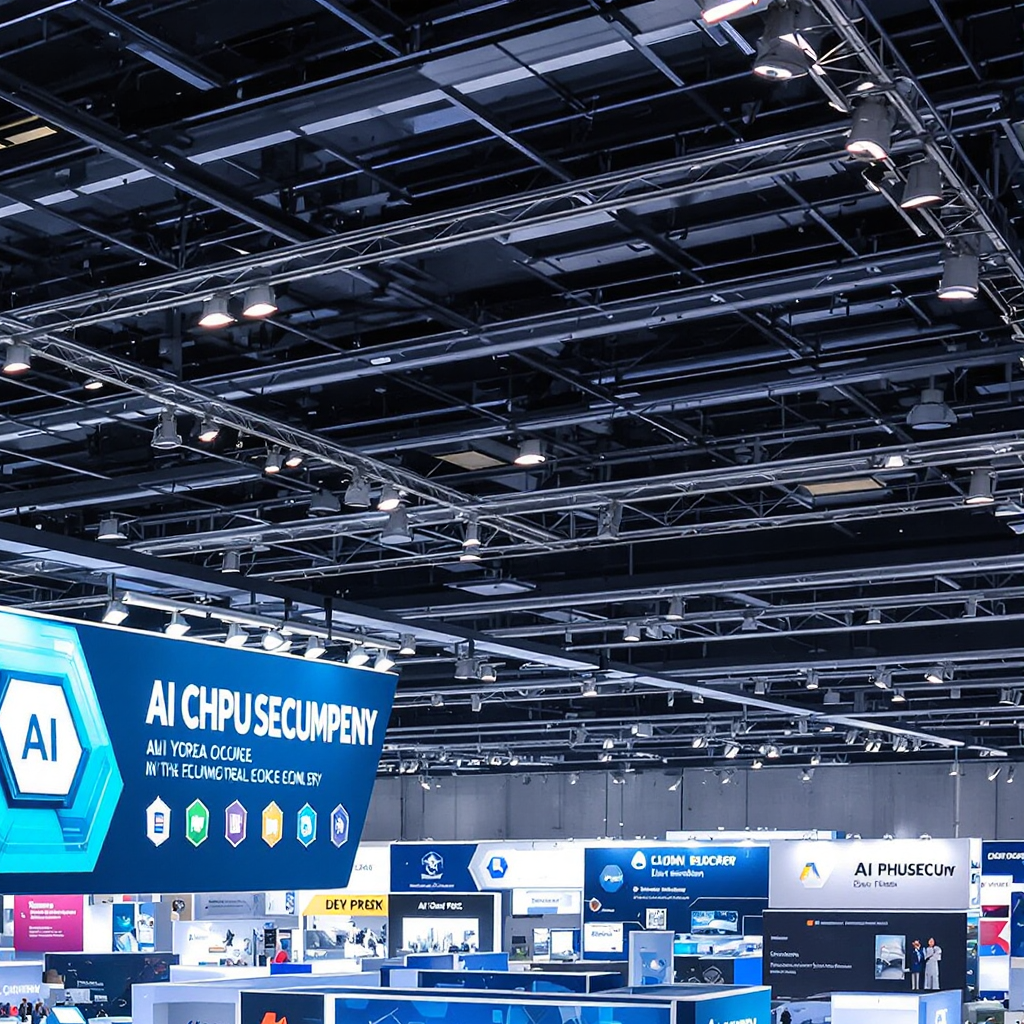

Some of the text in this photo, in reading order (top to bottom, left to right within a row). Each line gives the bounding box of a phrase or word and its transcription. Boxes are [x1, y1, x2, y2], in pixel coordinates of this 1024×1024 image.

[145, 679, 378, 746] AI CHPU SECUMPENY
[21, 713, 57, 762] AI
[854, 862, 872, 877] AI
